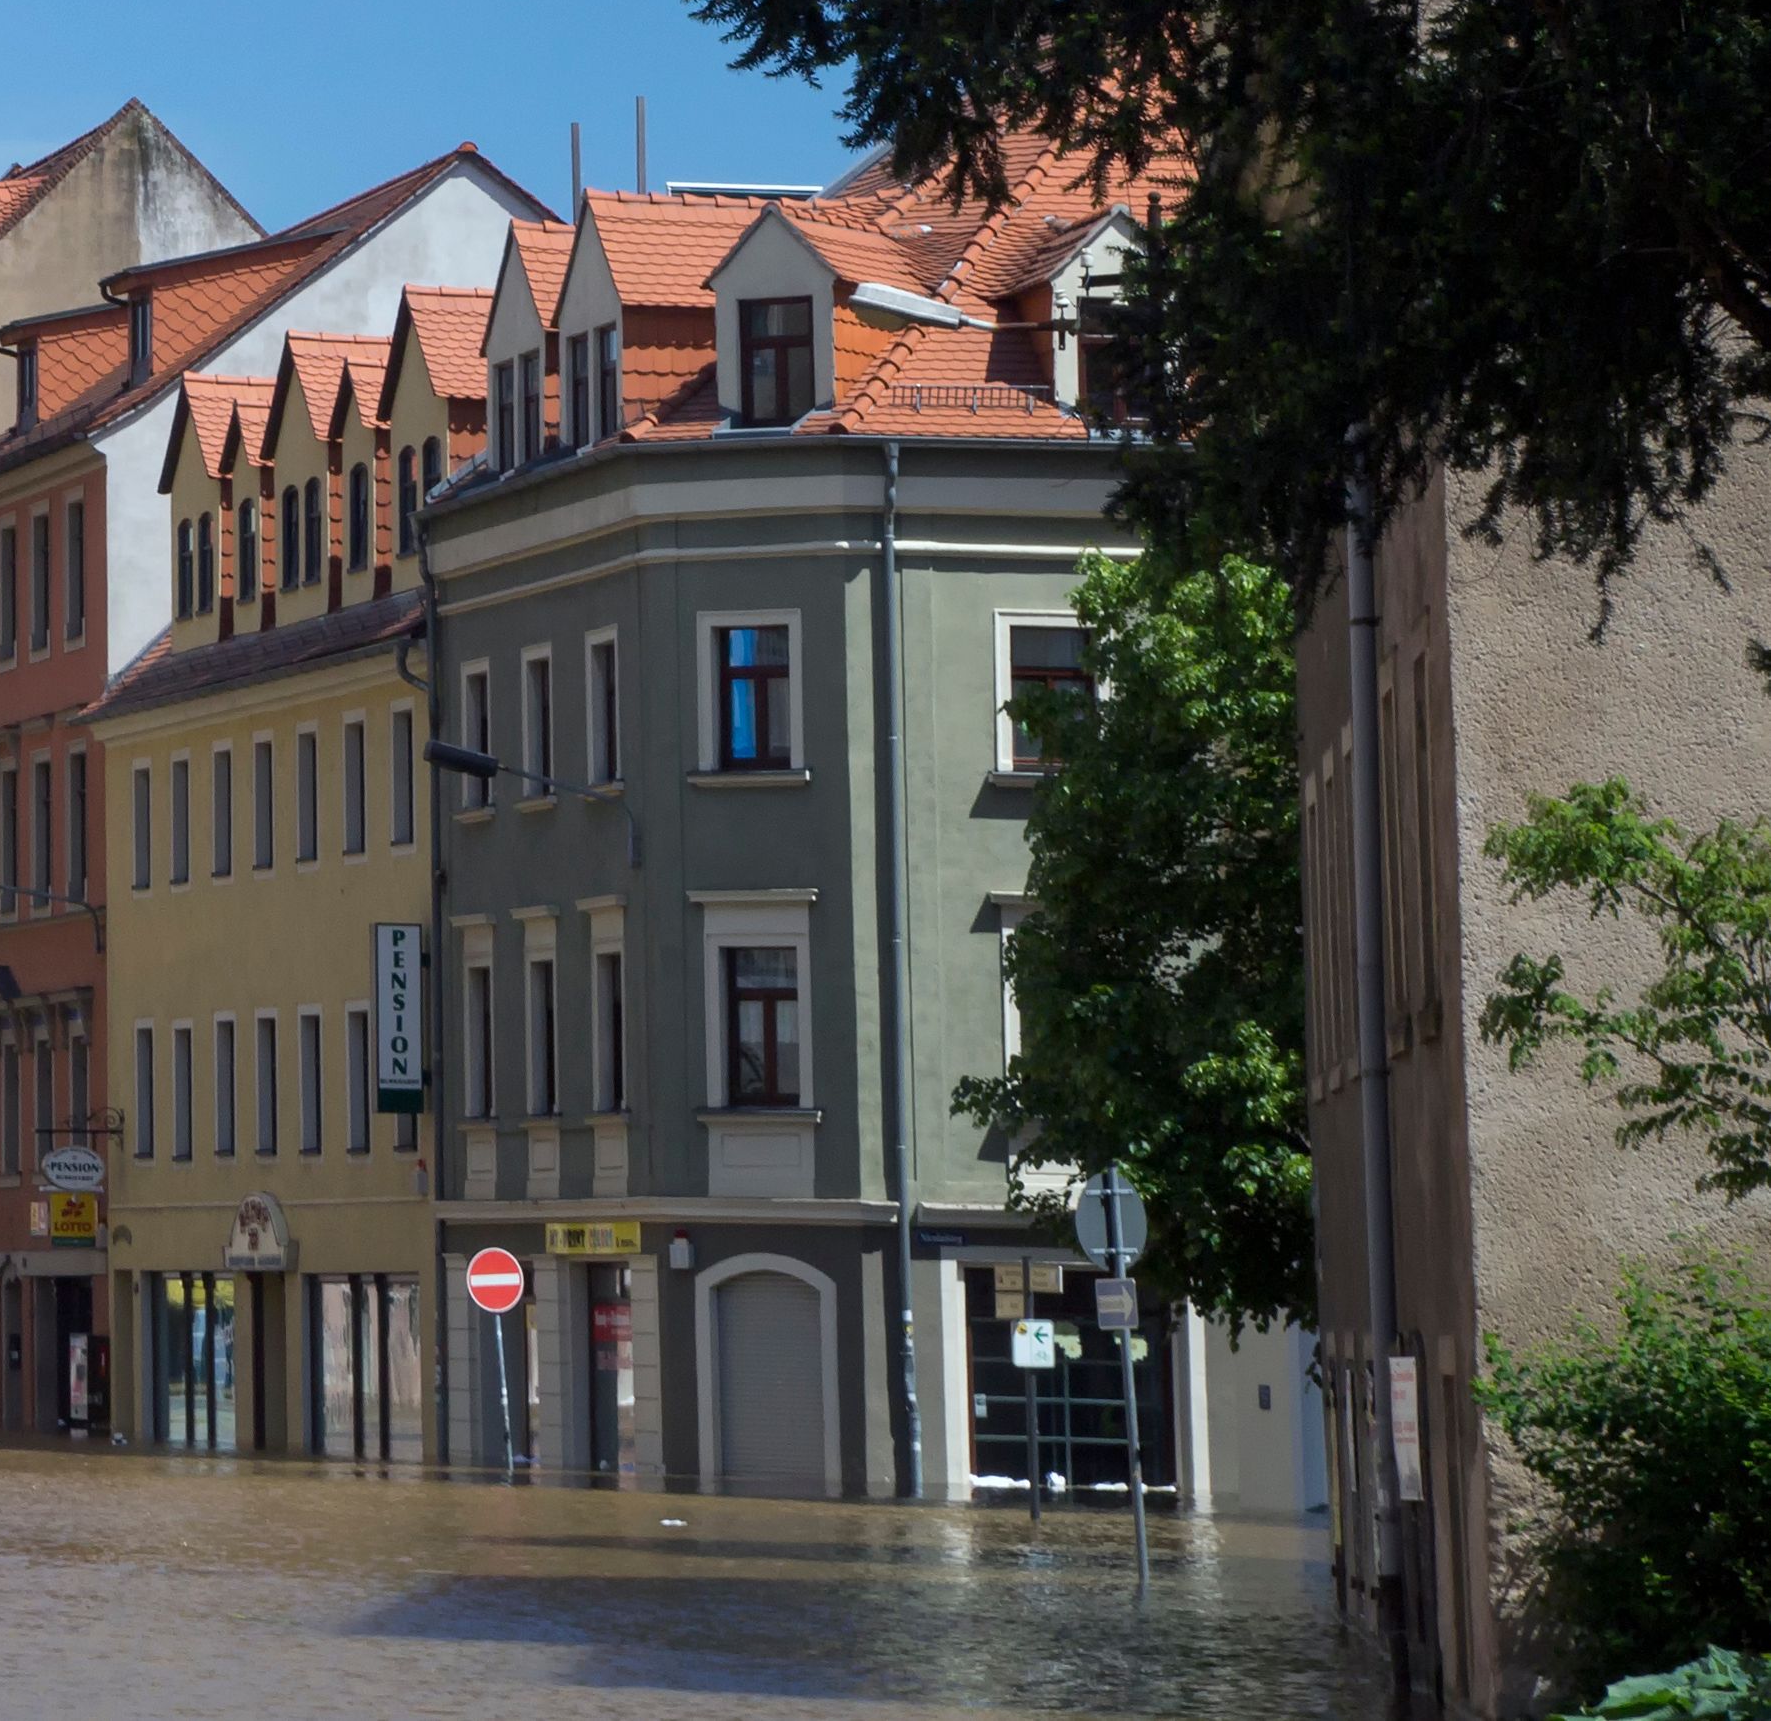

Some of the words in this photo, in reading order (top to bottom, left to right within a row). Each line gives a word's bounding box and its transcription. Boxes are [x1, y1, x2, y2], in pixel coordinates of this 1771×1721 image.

[391, 930, 409, 1075] PENSION
[50, 1161, 99, 1173] PENSION
[54, 1222, 92, 1232] LOTTO
